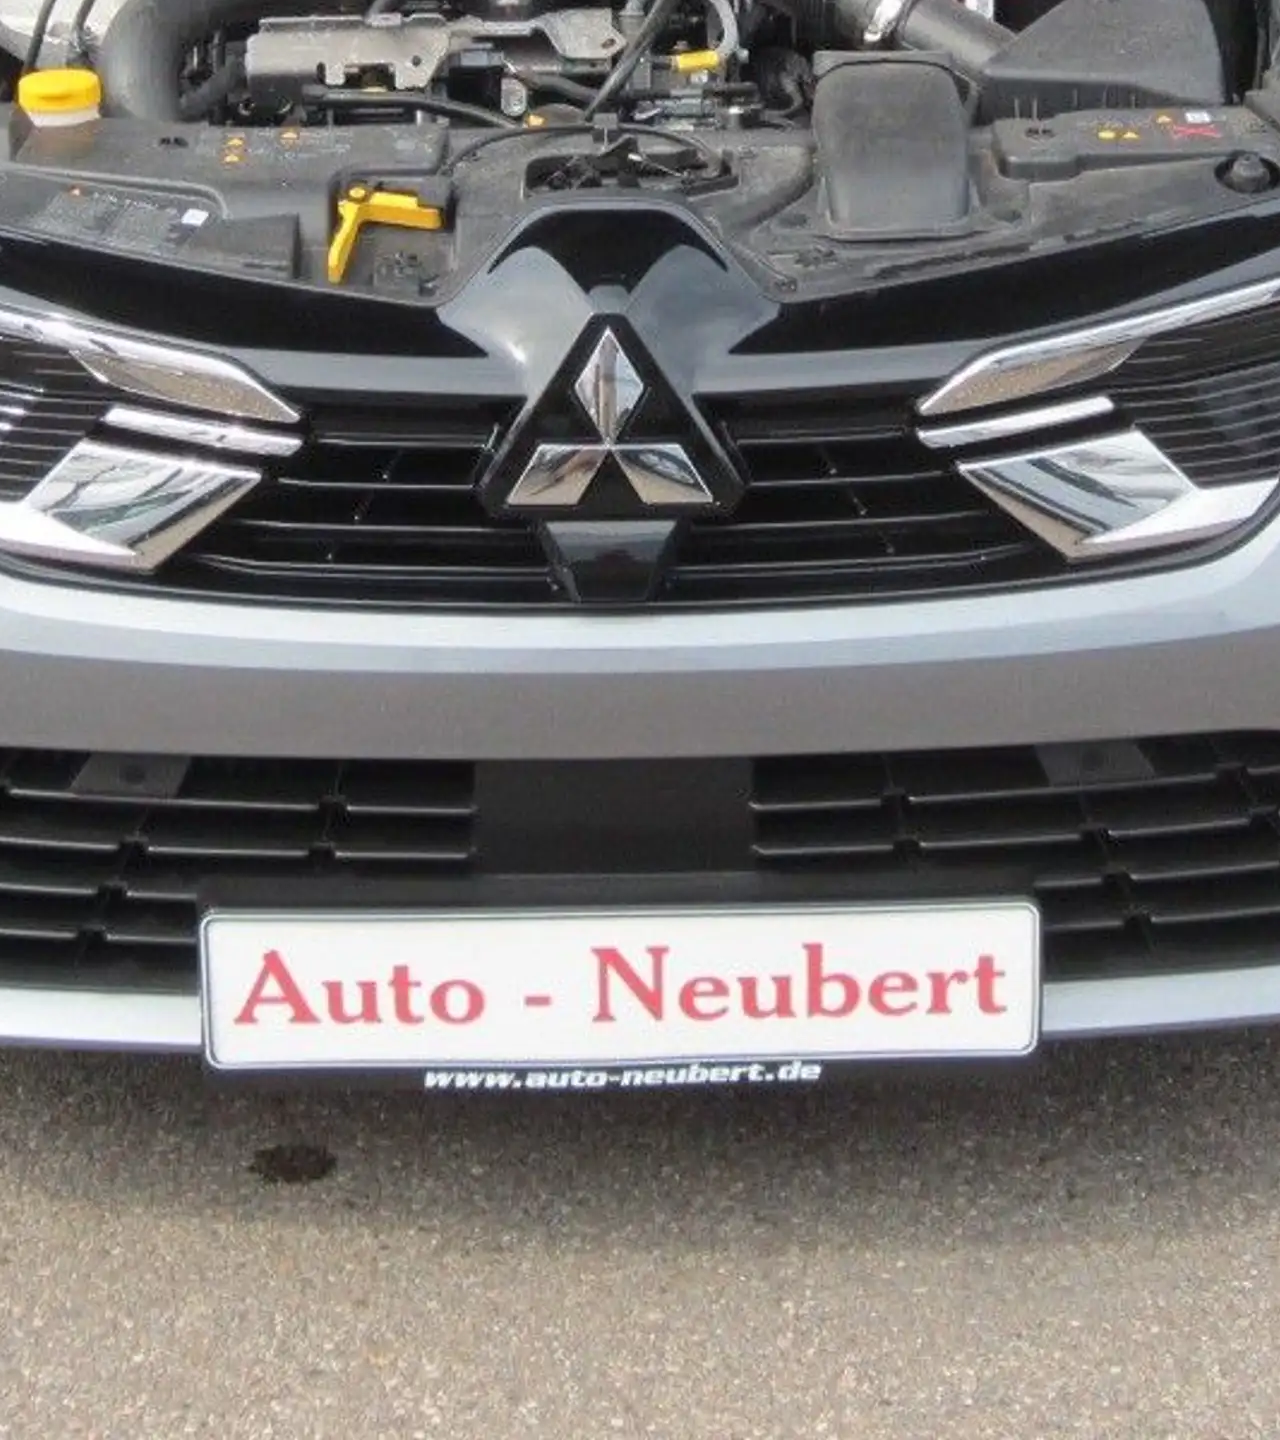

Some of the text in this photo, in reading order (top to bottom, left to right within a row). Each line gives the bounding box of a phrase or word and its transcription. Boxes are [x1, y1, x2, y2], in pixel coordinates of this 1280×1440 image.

[233, 949, 484, 1024] Auto
[590, 942, 1007, 1022] Neubert
[423, 1060, 822, 1090] www.auto-neubert.de
